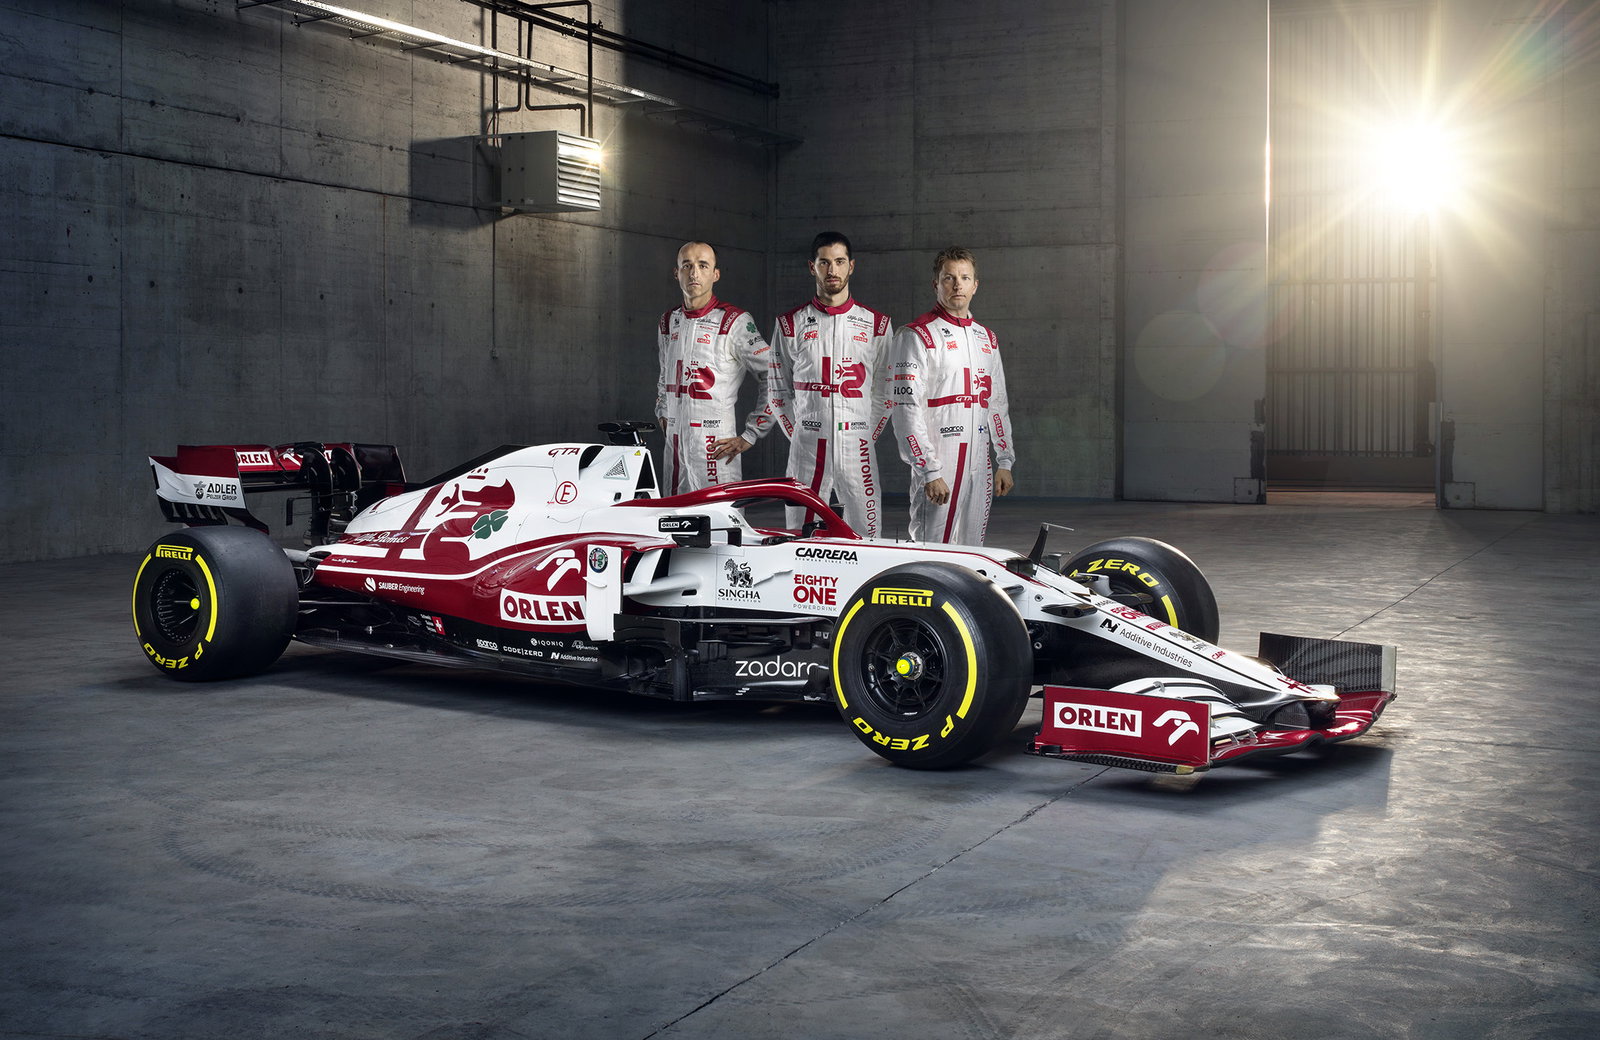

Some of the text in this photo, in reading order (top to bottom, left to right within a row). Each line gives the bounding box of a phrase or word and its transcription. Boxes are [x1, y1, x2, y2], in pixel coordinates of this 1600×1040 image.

[894, 386, 913, 395] iLOQ
[940, 425, 964, 433] sparco
[548, 447, 580, 457] GTA
[705, 435, 719, 484] ROBERT
[859, 438, 874, 497] ANTONIO
[207, 483, 237, 495] ADLER
[560, 484, 572, 502] E
[156, 544, 193, 560] PIRELLI
[795, 547, 858, 561] CARRERA
[793, 574, 838, 587] EIGHTY
[1086, 558, 1160, 588] ZERO
[378, 582, 425, 595] SAUBER Engineering
[717, 588, 761, 600] SINGHA
[793, 585, 837, 605] ONE
[871, 587, 934, 607] PIRELLI
[503, 595, 585, 622] ORLEN
[143, 642, 204, 669] P ZERO
[1119, 628, 1193, 668] Additive Industries
[1059, 706, 1137, 733] ORLEN
[852, 714, 955, 751] P ZERO
